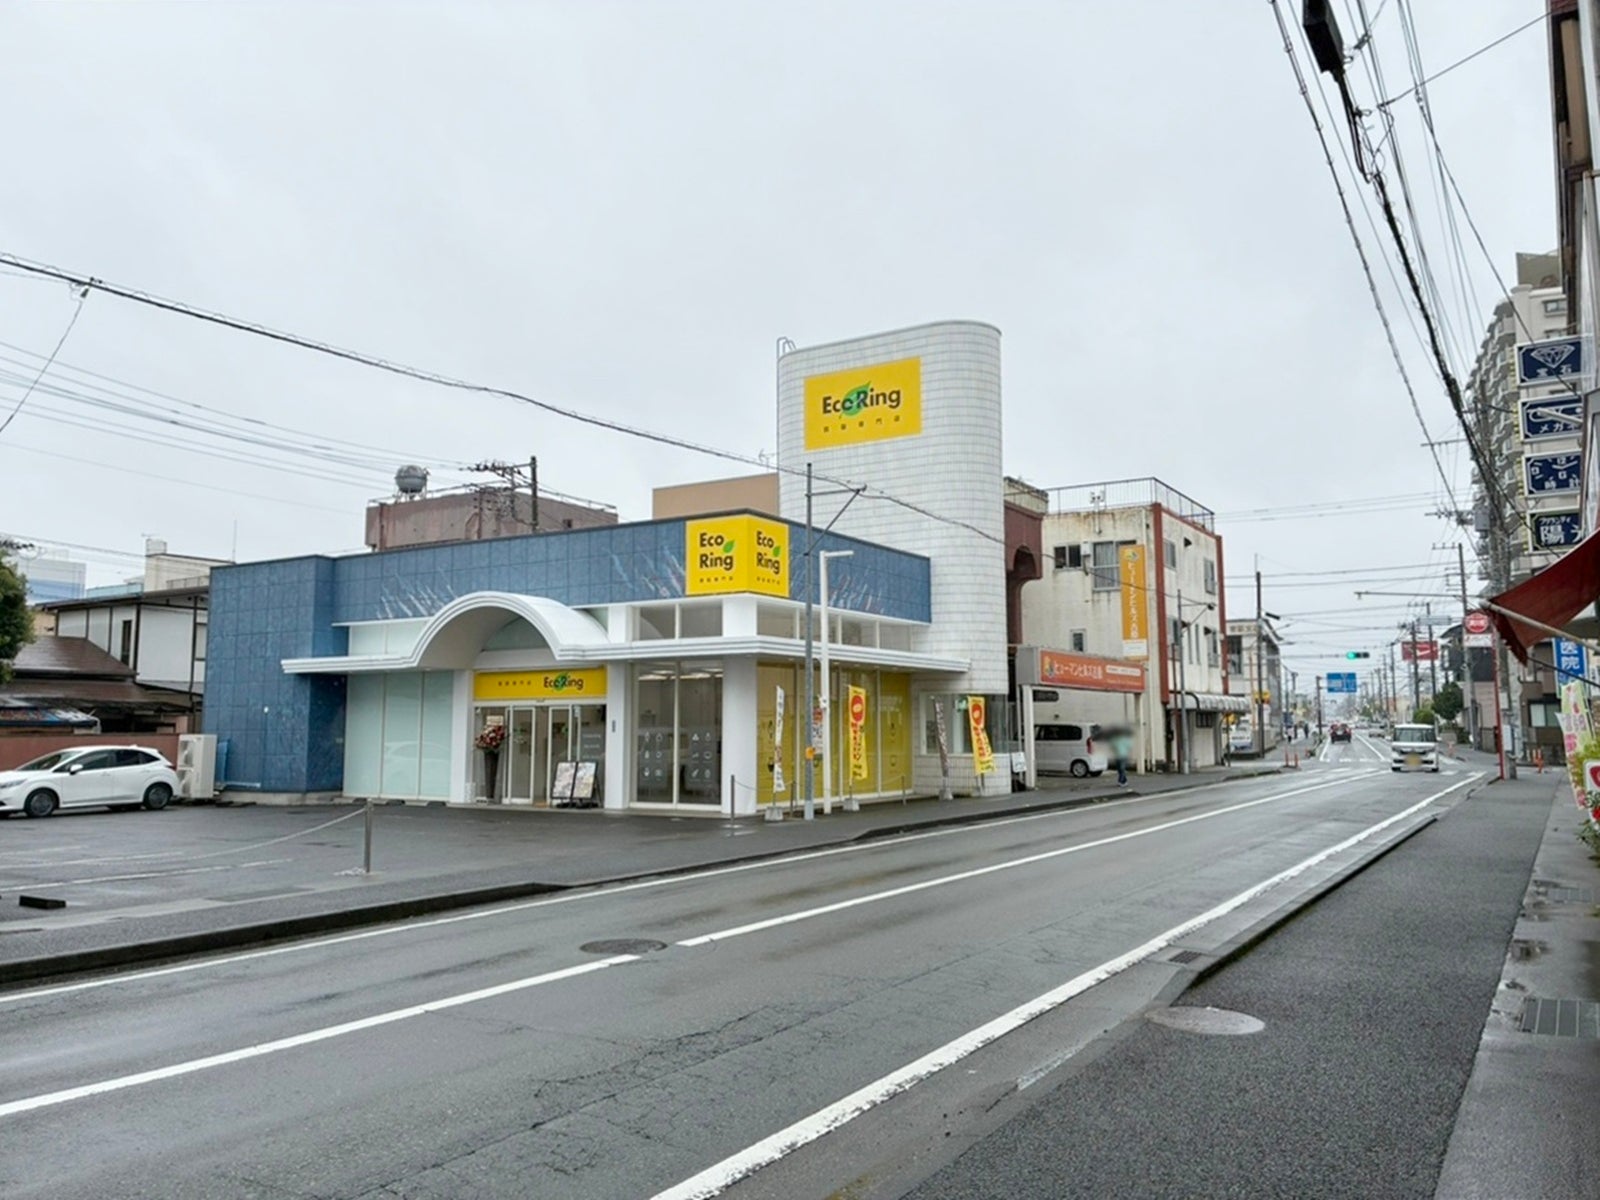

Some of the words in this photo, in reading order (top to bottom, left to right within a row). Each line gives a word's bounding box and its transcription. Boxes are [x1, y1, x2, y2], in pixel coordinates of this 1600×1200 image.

[822, 387, 901, 415] EcoRing
[699, 532, 725, 548] Eco
[756, 530, 775, 549] Eco
[699, 552, 734, 571] Ring
[756, 552, 781, 575] Ring
[543, 675, 584, 691] EcoRing
